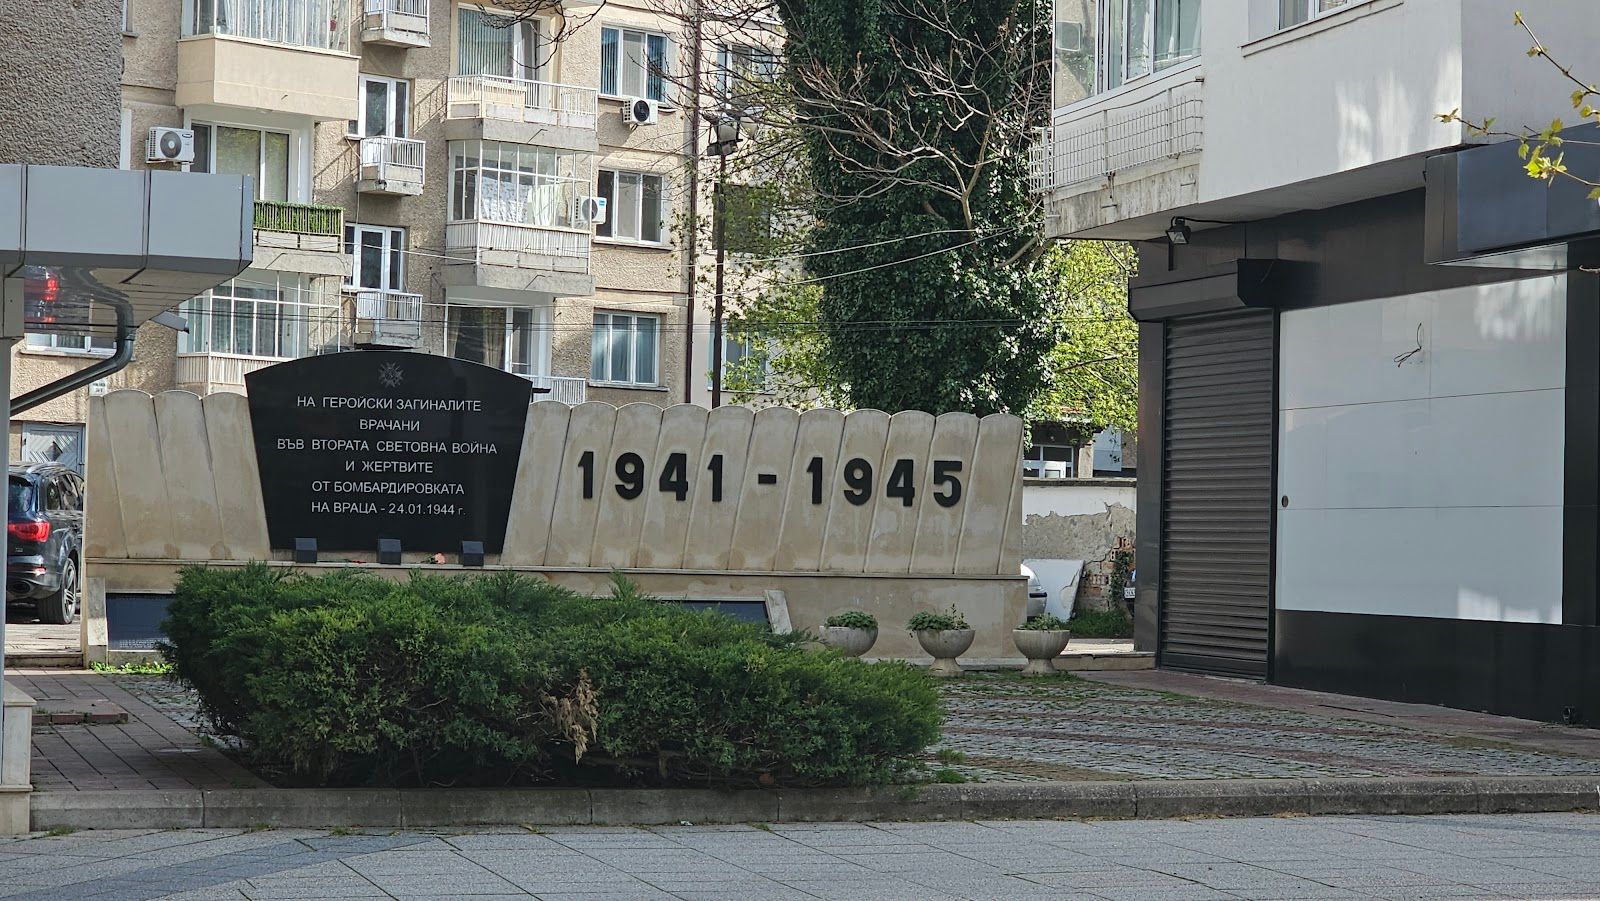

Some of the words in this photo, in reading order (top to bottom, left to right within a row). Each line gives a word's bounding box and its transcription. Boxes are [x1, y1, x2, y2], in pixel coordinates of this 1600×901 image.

[296, 395, 315, 408] НА
[322, 395, 392, 410] ГЕРОЙСКИ
[396, 398, 481, 412] ЗАГИНАЛИТЕ
[359, 418, 419, 432] ВРАЧАНИ
[277, 438, 304, 450] ВЪВ
[311, 438, 369, 452] ВТОРАТА
[376, 440, 447, 453] СВЕТОВНА
[452, 440, 497, 454] ВОЙНА
[345, 460, 354, 472] И
[361, 460, 433, 474] ЖЕРТВИТЕ
[578, 451, 722, 502] 1941
[807, 457, 962, 507] 1945
[311, 480, 330, 492] ОТ
[334, 480, 464, 495] БОМБАРДИРОВКАТА
[311, 501, 329, 513] НА
[333, 501, 377, 515] ВРАЦА
[388, 502, 454, 515] 24.01.1944
